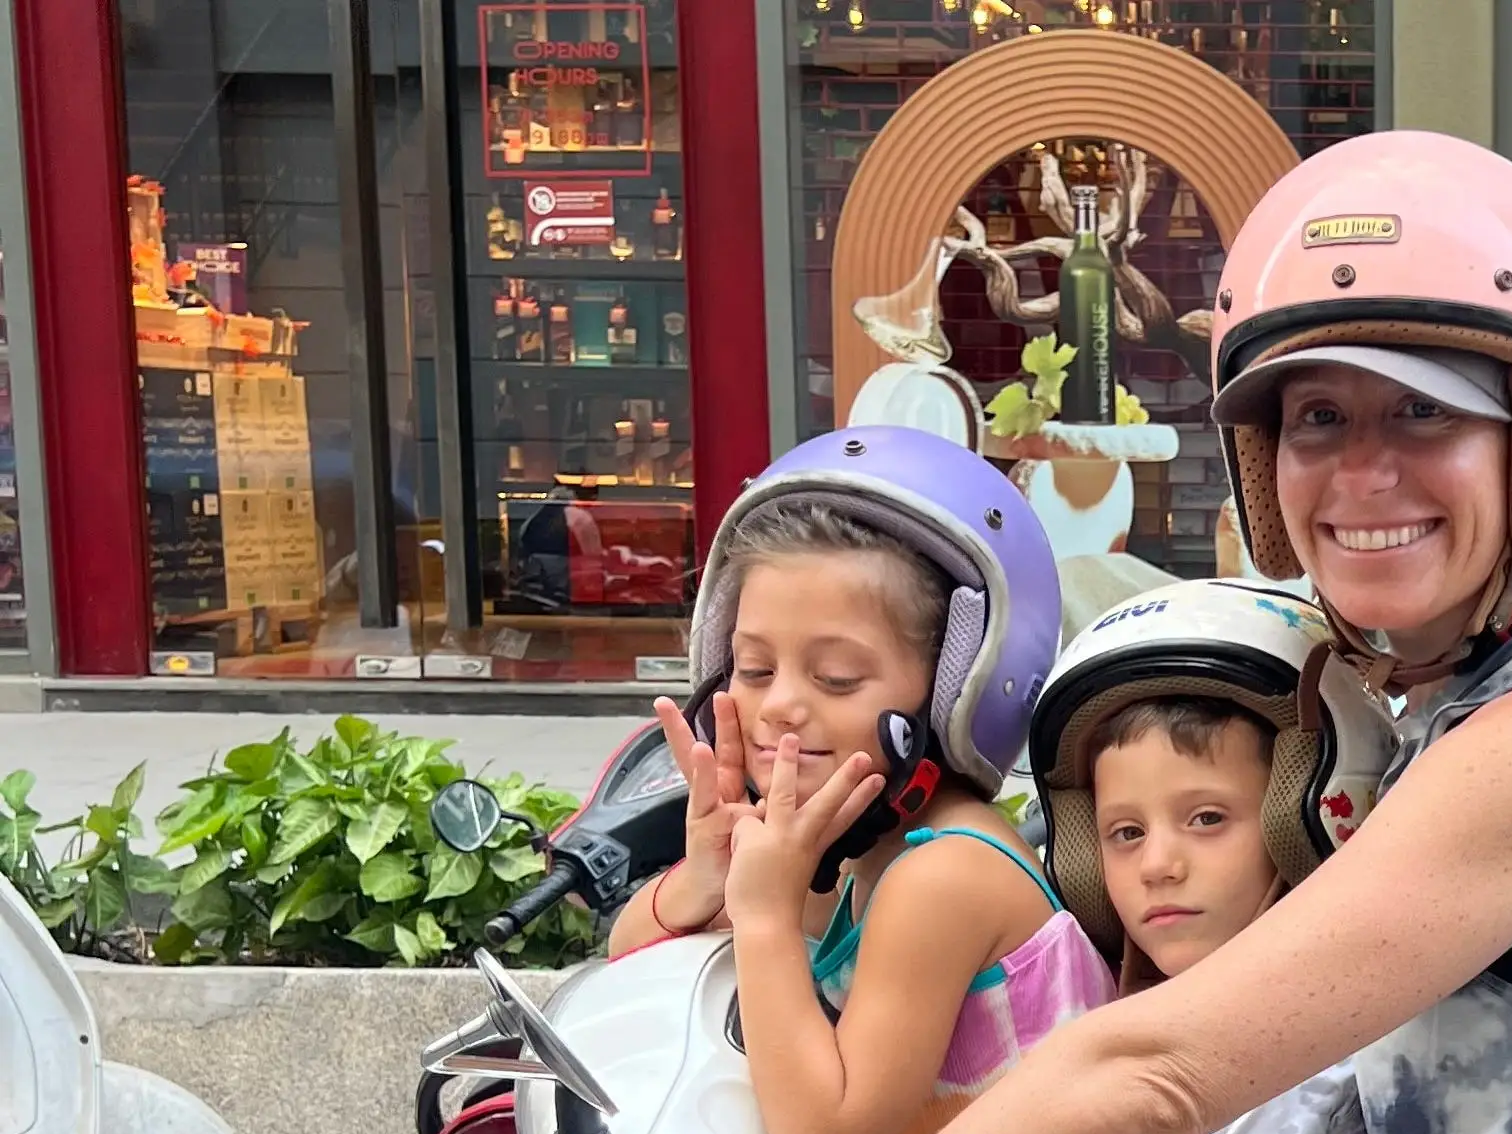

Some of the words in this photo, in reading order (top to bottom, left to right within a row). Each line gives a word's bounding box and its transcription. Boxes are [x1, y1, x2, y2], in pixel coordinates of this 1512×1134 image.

[513, 41, 620, 60] OPENING
[514, 67, 599, 86] HOURS
[195, 248, 228, 261] BEST
[1092, 599, 1170, 633] GIVI
